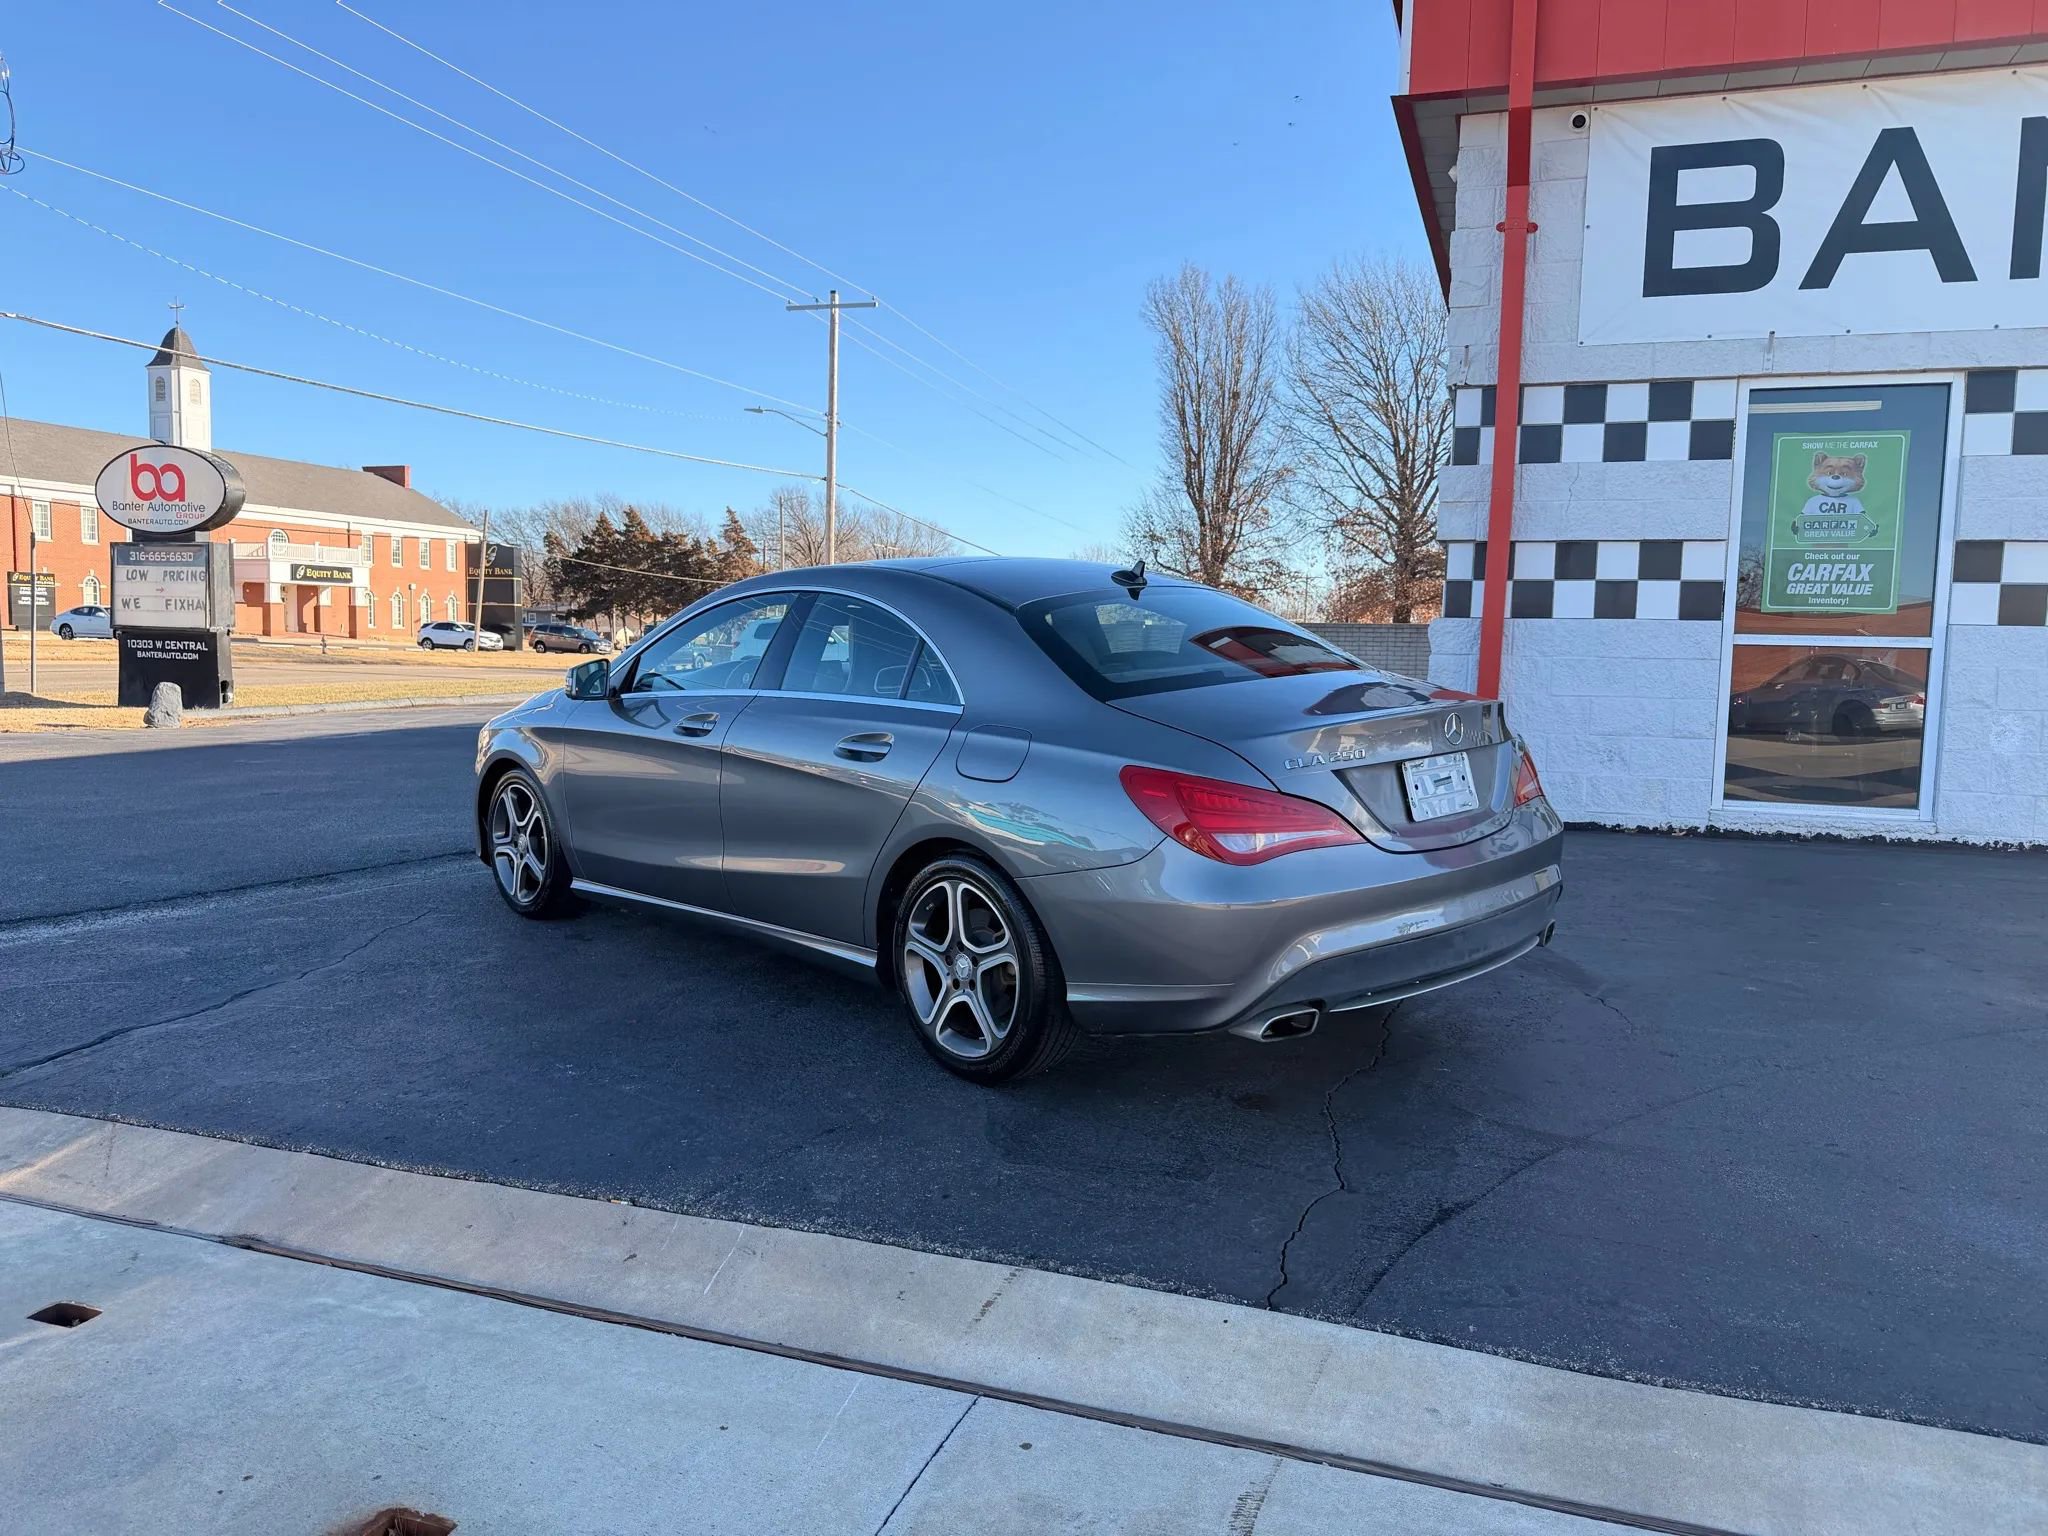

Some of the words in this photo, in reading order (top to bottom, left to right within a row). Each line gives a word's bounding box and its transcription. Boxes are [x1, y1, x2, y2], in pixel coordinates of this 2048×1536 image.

[1850, 441, 1879, 449] CARFAX
[112, 501, 144, 512] Banter
[147, 502, 205, 513] Automotive
[1819, 502, 1847, 513] CAR
[128, 518, 189, 526] BANTERAUTO.COM
[1804, 521, 1857, 530] CARFAX
[1804, 530, 1829, 538] GREAT
[129, 551, 194, 562] 316-665-6630
[1804, 552, 1829, 560] Check
[1831, 552, 1845, 560] out
[126, 569, 149, 581] LOW
[162, 569, 206, 582] PRICING
[469, 567, 493, 576] EQTY
[1787, 563, 1875, 582] CARFAX
[1786, 582, 1829, 595] GREAT
[1831, 583, 1874, 595] VALUE
[122, 598, 141, 609] WE
[1808, 597, 1849, 606] Inventory!
[127, 639, 154, 649] 10303
[155, 640, 164, 649] W
[164, 640, 208, 651] CENTRAL
[137, 651, 199, 661] BANTERAUTO.COM
[1284, 755, 1325, 769] CLA
[1329, 749, 1366, 762] 250
